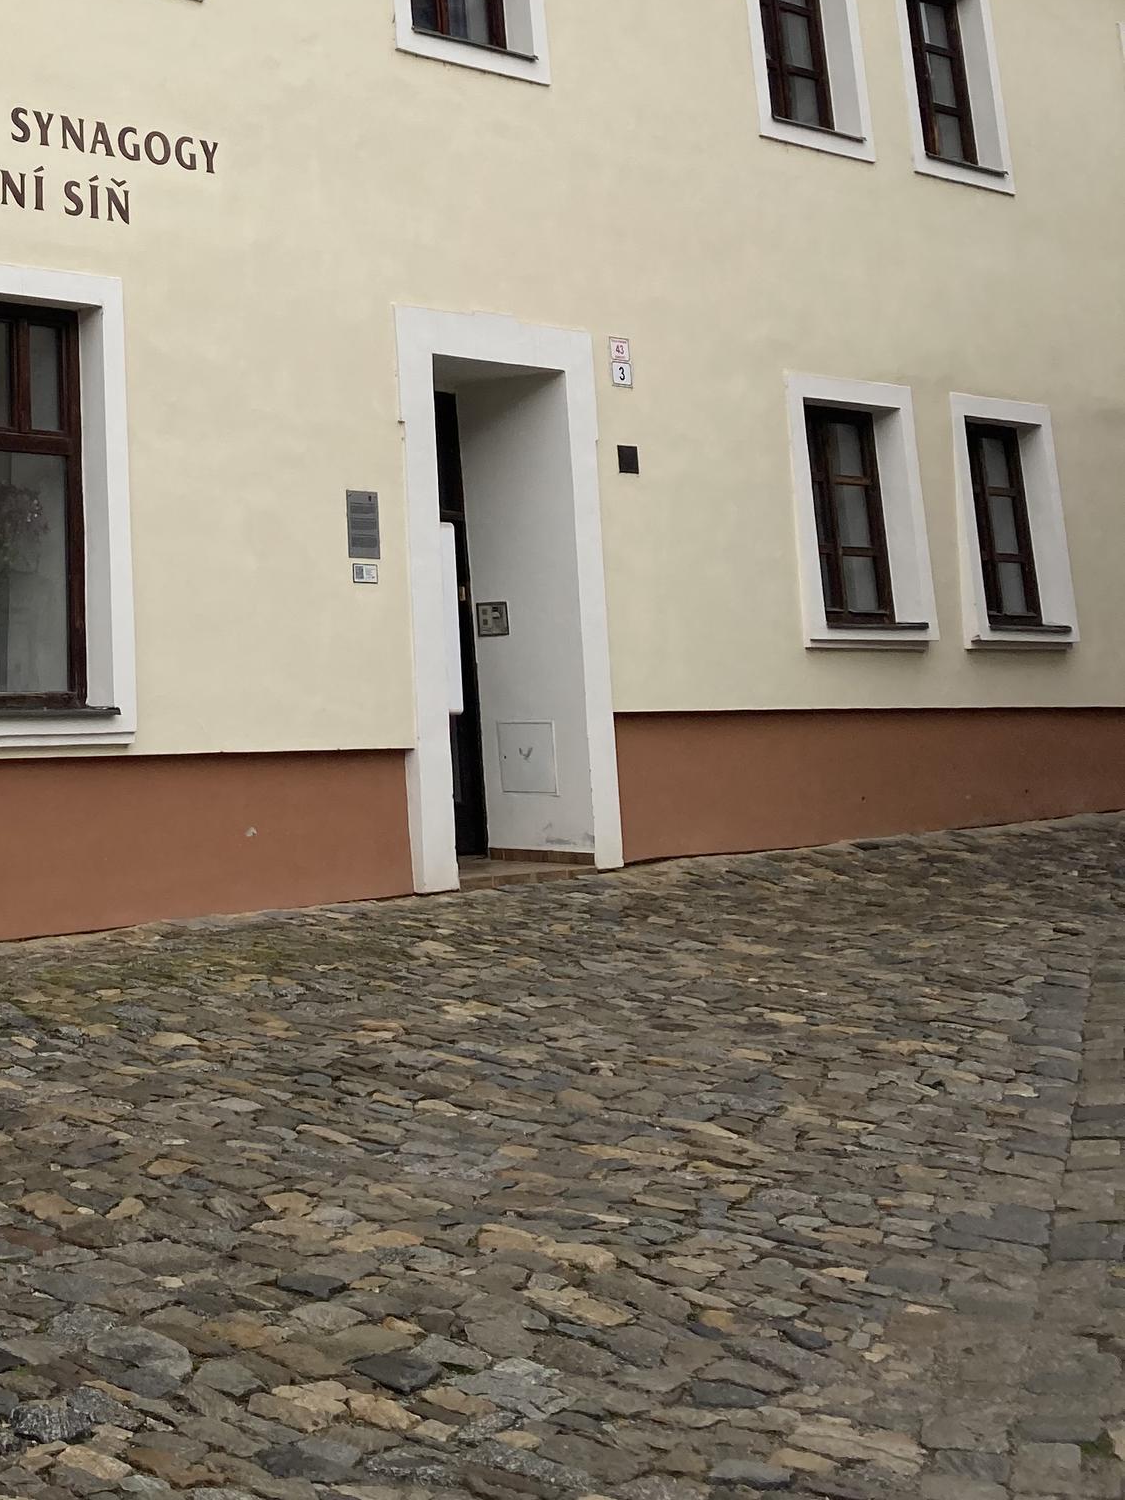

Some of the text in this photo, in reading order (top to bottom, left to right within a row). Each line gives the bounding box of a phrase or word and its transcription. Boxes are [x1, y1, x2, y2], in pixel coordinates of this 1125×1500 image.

[10, 106, 220, 175] SYNAGOGY
[63, 174, 132, 226] SÍŇ
[615, 344, 625, 354] 43
[618, 366, 625, 381] 3
